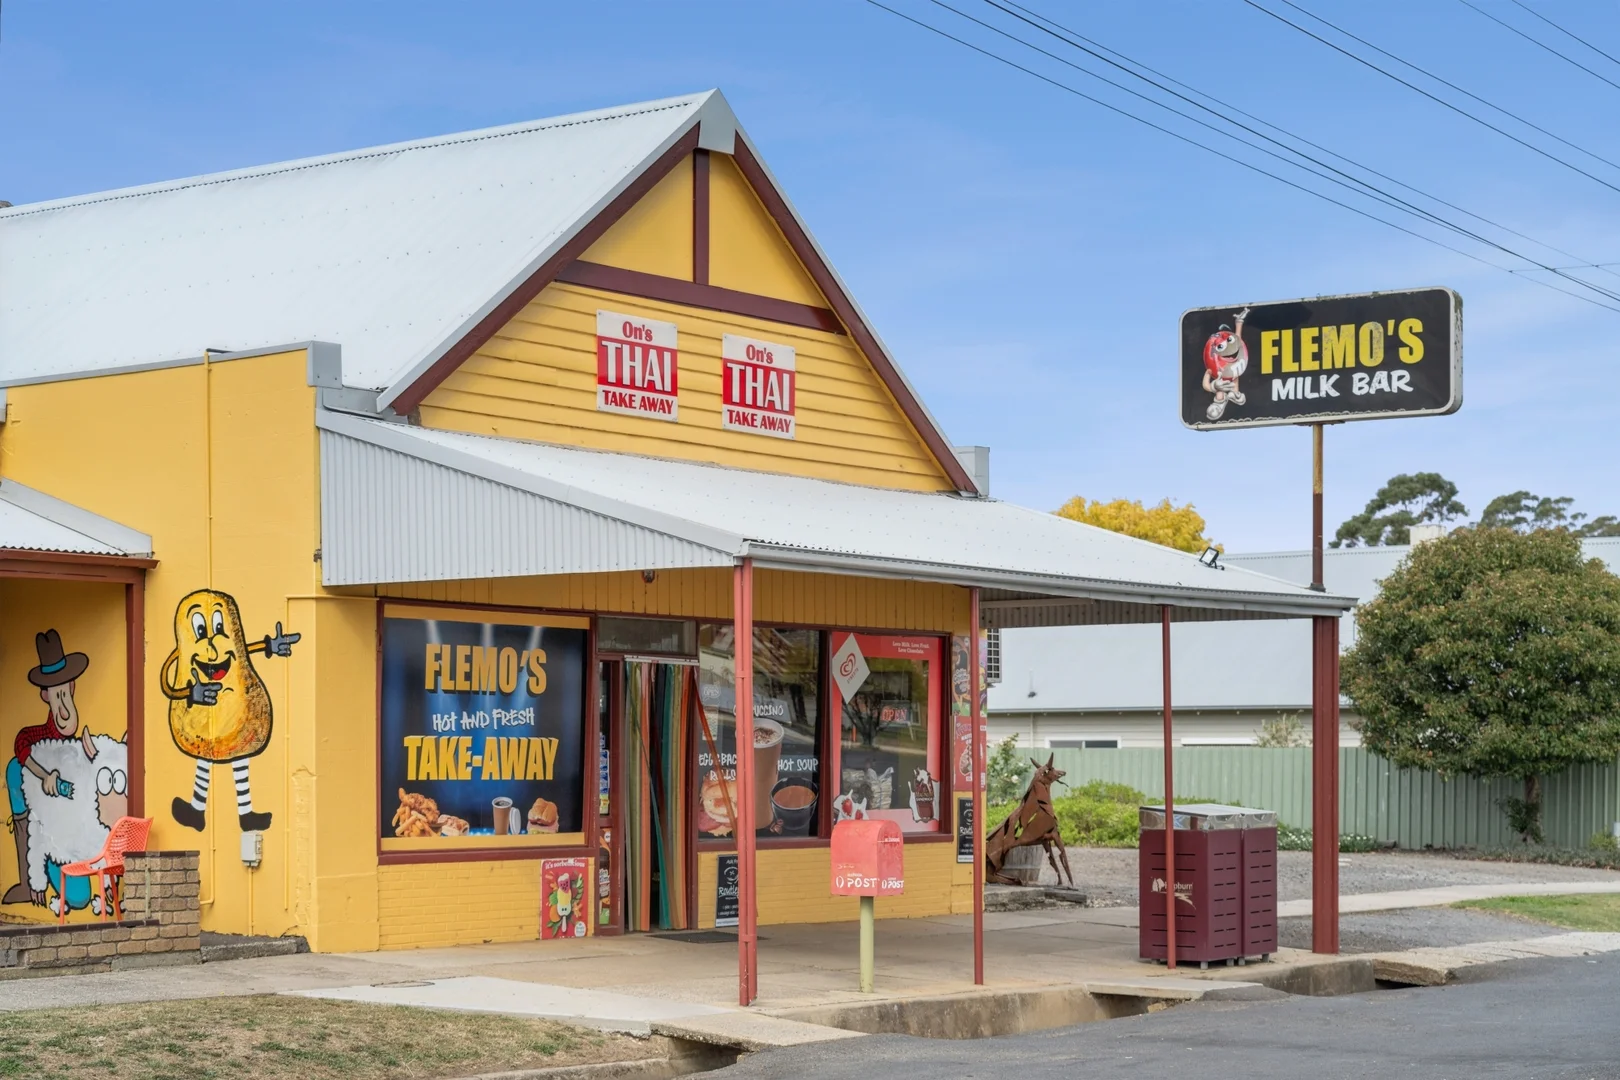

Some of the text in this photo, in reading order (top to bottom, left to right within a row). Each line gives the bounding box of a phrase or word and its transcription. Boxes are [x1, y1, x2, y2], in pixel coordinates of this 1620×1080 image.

[622, 321, 653, 342] On's
[746, 343, 773, 364] On's
[1261, 317, 1424, 374] FLEMO'S
[601, 340, 672, 392] THAI
[727, 362, 790, 412] THAI
[1271, 369, 1413, 401] MILK BAR
[602, 389, 674, 414] TAKE AWAY
[727, 409, 791, 433] TAKE AWAY
[424, 643, 547, 696] FLEMO'S
[460, 710, 489, 730] AND
[492, 707, 535, 730] FRESH
[403, 735, 559, 781] TAKE-AWAY
[796, 757, 819, 771] SOUP
[847, 877, 877, 888] POST
[887, 879, 905, 889] POST
